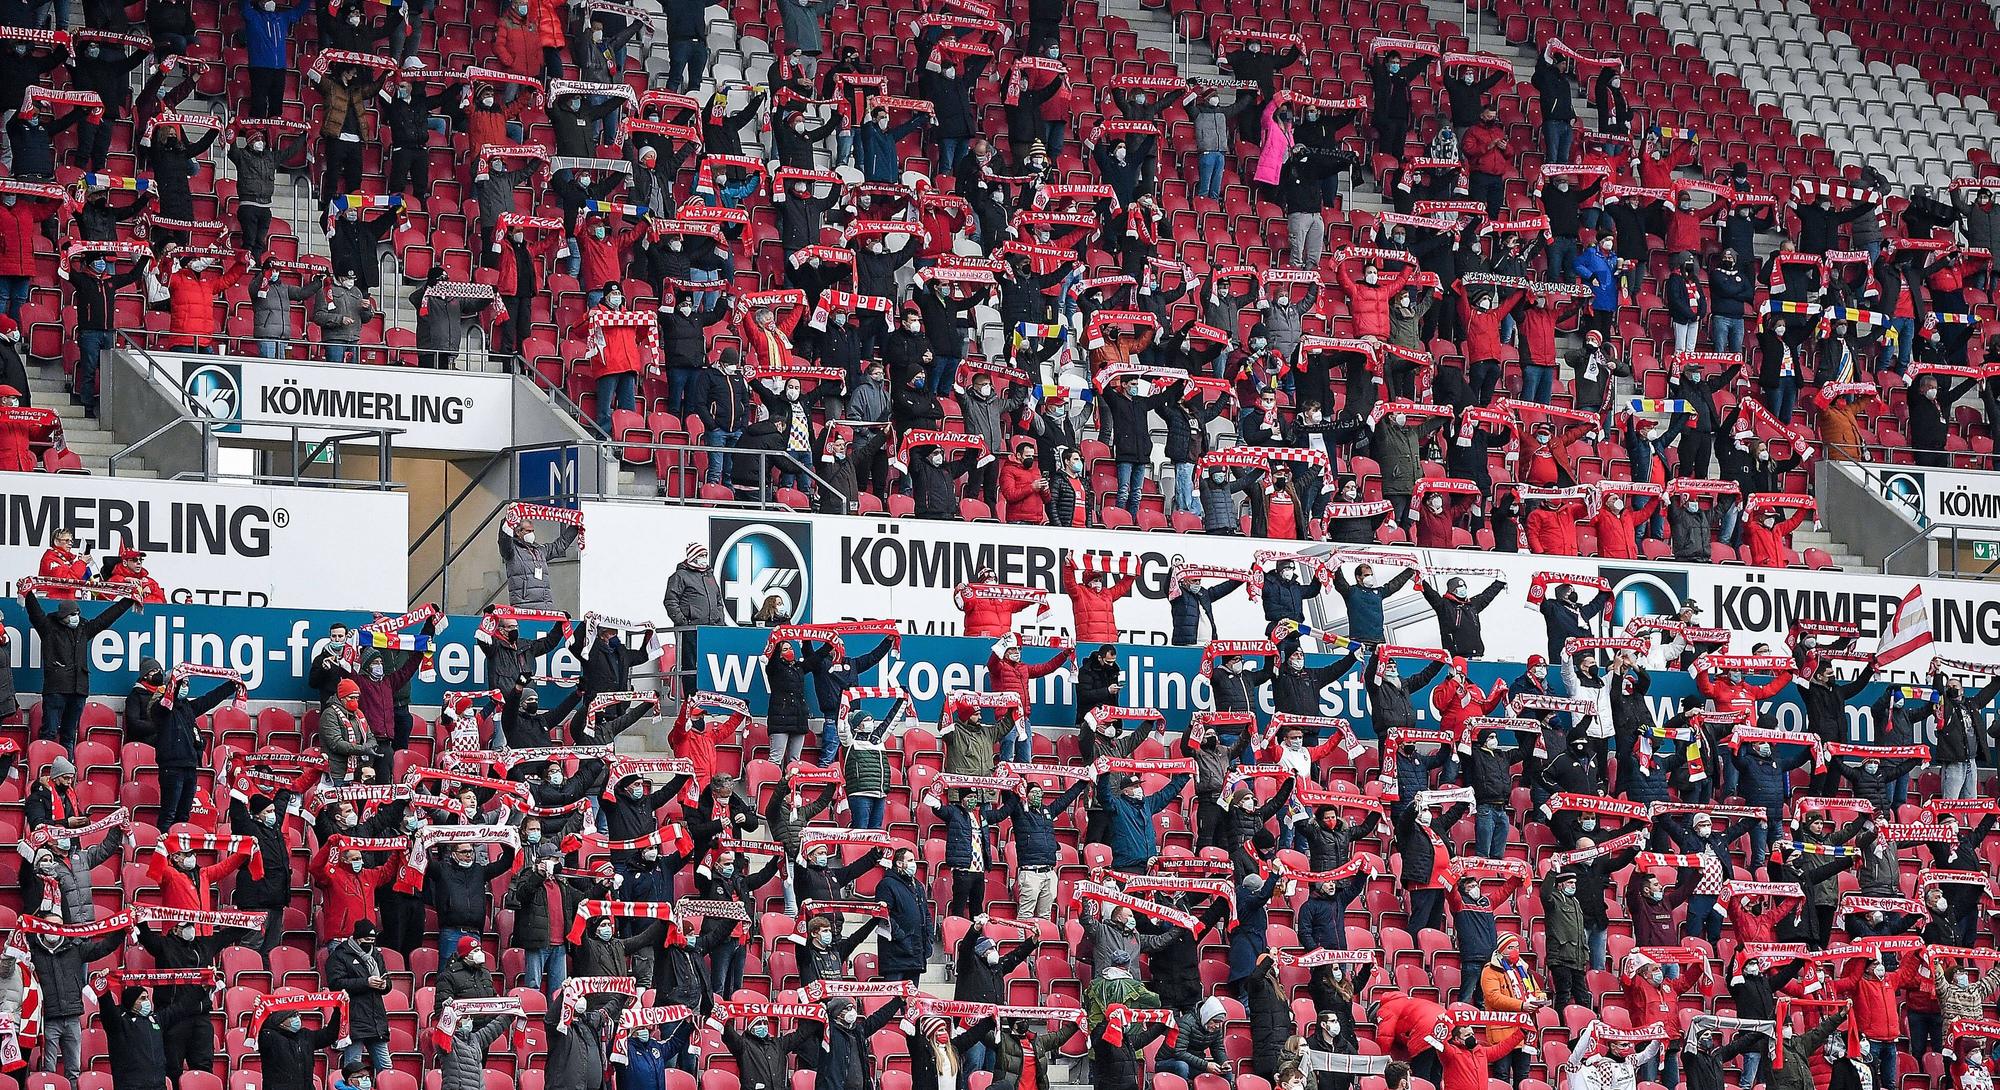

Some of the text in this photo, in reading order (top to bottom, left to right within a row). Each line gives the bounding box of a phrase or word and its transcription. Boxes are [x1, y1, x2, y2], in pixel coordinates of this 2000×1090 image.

[1, 26, 54, 39] MEENZER
[1142, 78, 1172, 86] MAINZ
[1432, 157, 1458, 165] MAINZ
[1074, 184, 1098, 194] MAINZ
[1099, 186, 1110, 194] 05
[1050, 214, 1080, 222] MAINZ
[1083, 216, 1094, 224] 05
[1506, 218, 1542, 229] MAINZ 05
[1034, 246, 1062, 256] MAINZ
[1063, 249, 1074, 258] 05
[962, 258, 1003, 270] MAINZ 05
[785, 294, 798, 303] 05
[1704, 352, 1732, 361] MAINZ
[934, 432, 965, 442] MAINZ
[968, 435, 980, 444] 05
[1228, 454, 1258, 466] MAINZ
[1433, 481, 1451, 489] MEIN
[546, 508, 578, 522] MAINZ
[1568, 574, 1599, 584] MAINZ
[406, 604, 432, 625] 2004
[514, 607, 538, 616] MEIN
[1232, 642, 1262, 651] MAINZ
[1744, 658, 1772, 667] MAINZ
[1776, 658, 1786, 667] 05
[342, 786, 392, 800] MAINZ
[1598, 800, 1631, 814] MAINZ
[1634, 806, 1646, 816] 05
[1910, 828, 1943, 838] MAINZ
[110, 913, 129, 927] 05
[200, 913, 217, 924] UND
[1884, 939, 1912, 948] MAINZ
[1328, 951, 1356, 960] MAINZ
[1358, 952, 1368, 960] 05
[1830, 946, 1862, 956] VEREIN
[276, 993, 334, 1006] NEVER WALK
[772, 1005, 816, 1018] MAINZ
[1480, 1011, 1516, 1024] MAINZ
